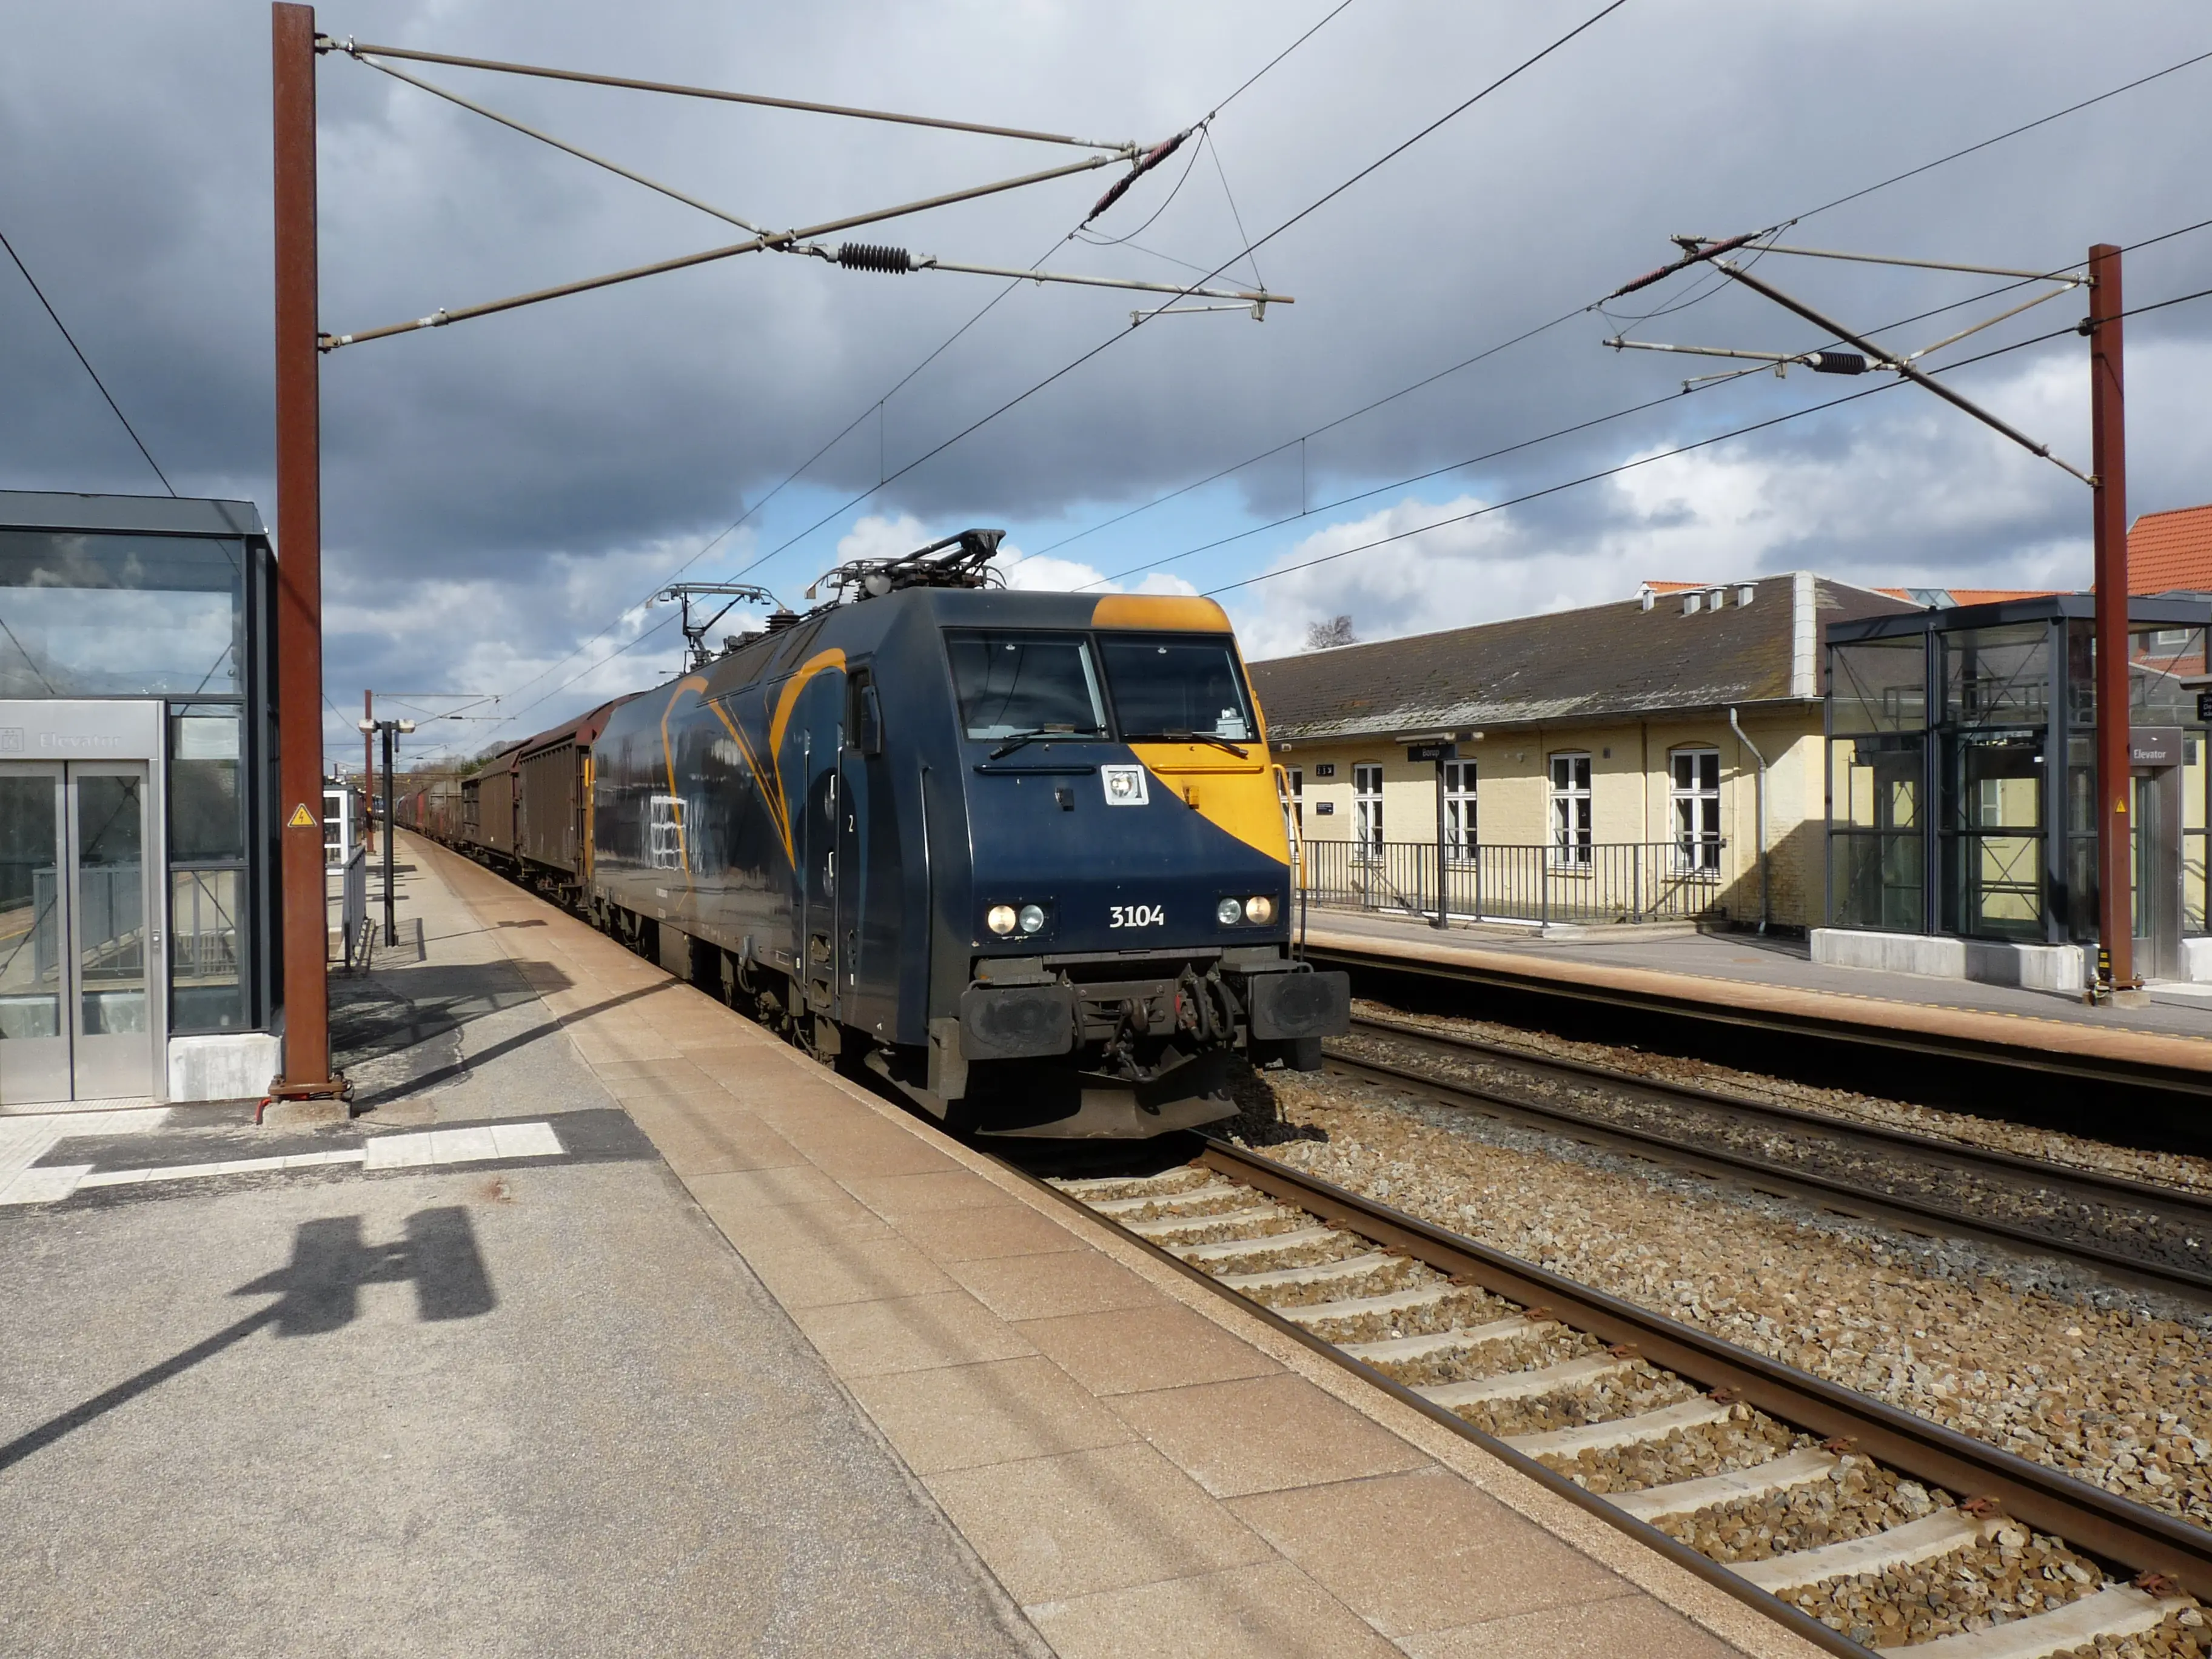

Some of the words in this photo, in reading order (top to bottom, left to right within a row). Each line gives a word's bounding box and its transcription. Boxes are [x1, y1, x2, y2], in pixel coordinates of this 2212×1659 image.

[39, 731, 122, 748] Elevator
[2134, 749, 2167, 759] Elevator
[849, 814, 854, 832] 2
[1109, 905, 1164, 928] 3104
